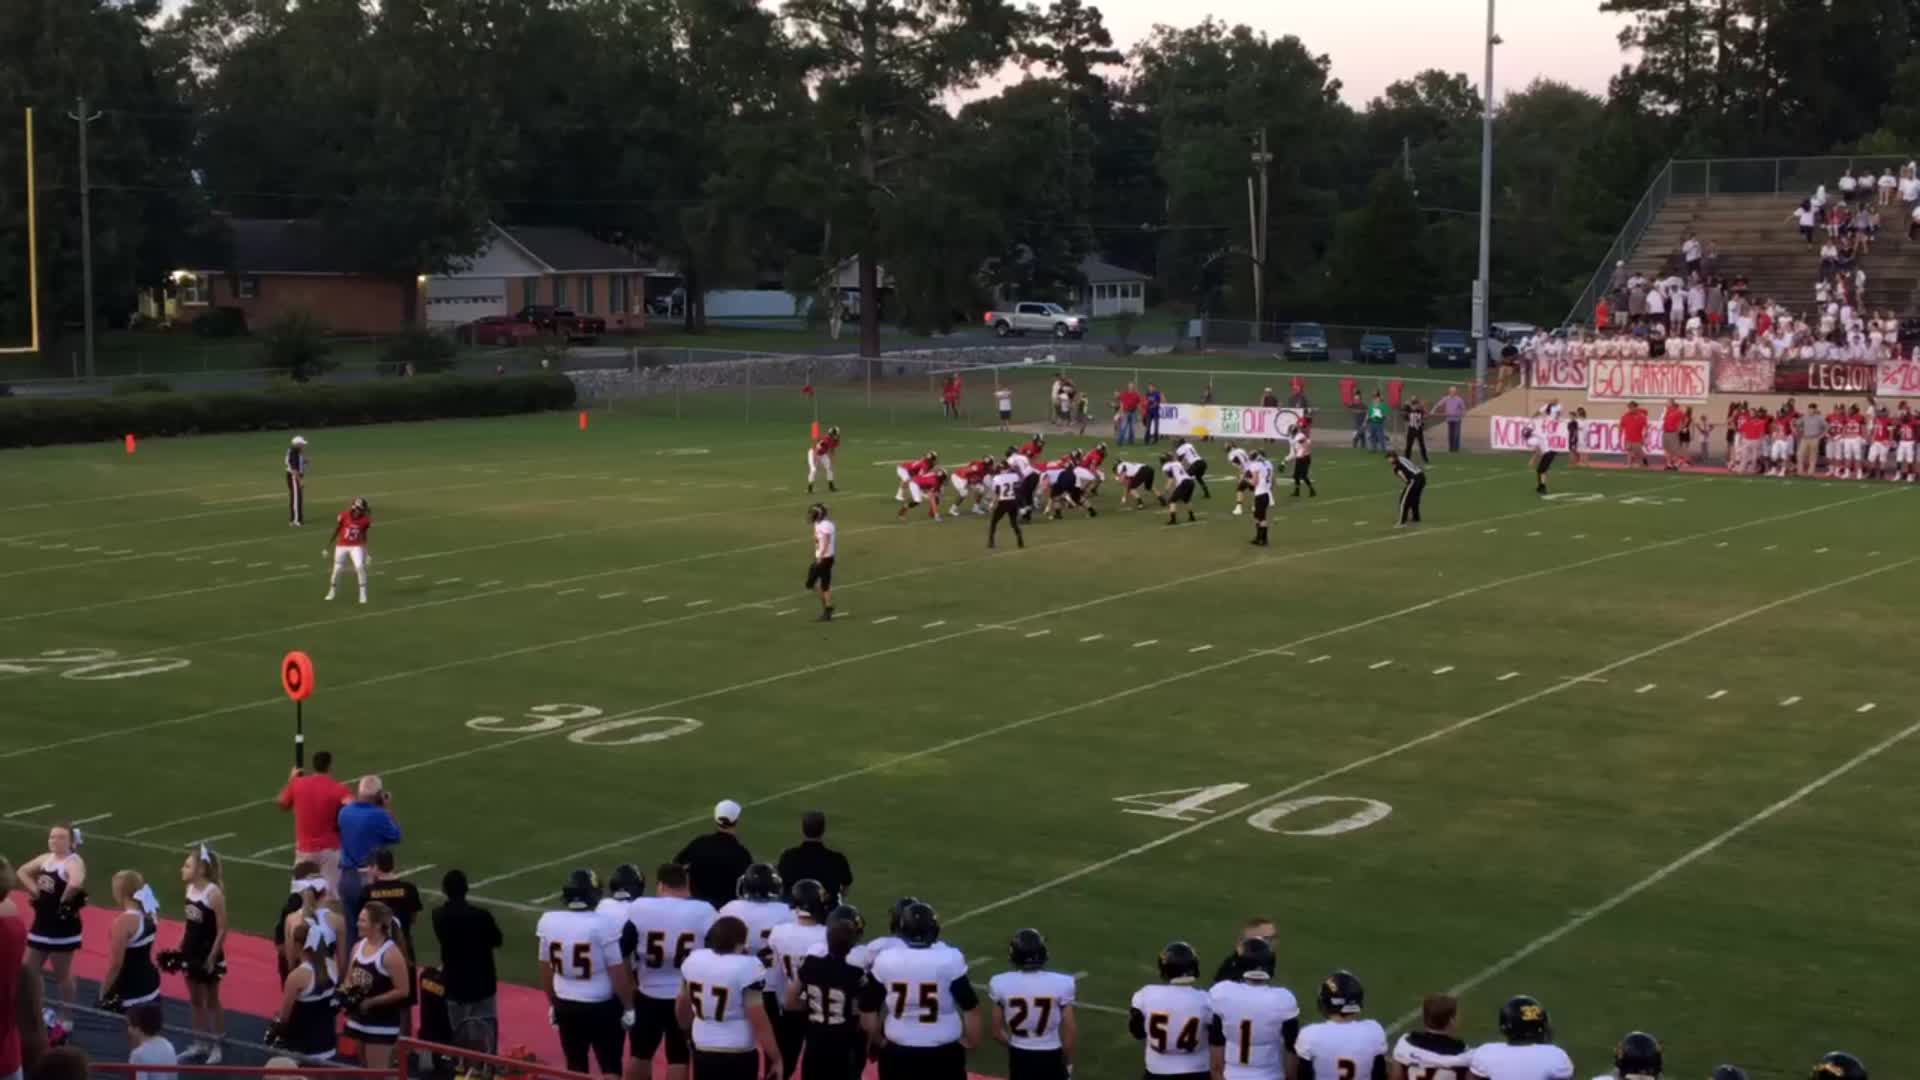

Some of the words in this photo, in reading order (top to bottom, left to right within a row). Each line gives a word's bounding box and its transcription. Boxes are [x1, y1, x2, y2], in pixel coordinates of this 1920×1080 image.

[1536, 359, 1586, 385] WCS
[1593, 362, 1625, 397] GO
[1631, 363, 1705, 395] WARRIORS
[1808, 363, 1877, 391] LEGION
[466, 703, 703, 745] 30
[1112, 782, 1393, 836] 40
[549, 941, 593, 980] 65
[646, 931, 697, 970] 56
[891, 982, 938, 1024] 75
[1007, 997, 1053, 1038] 27
[1147, 1013, 1200, 1054] 54
[1239, 1019, 1253, 1065] 1
